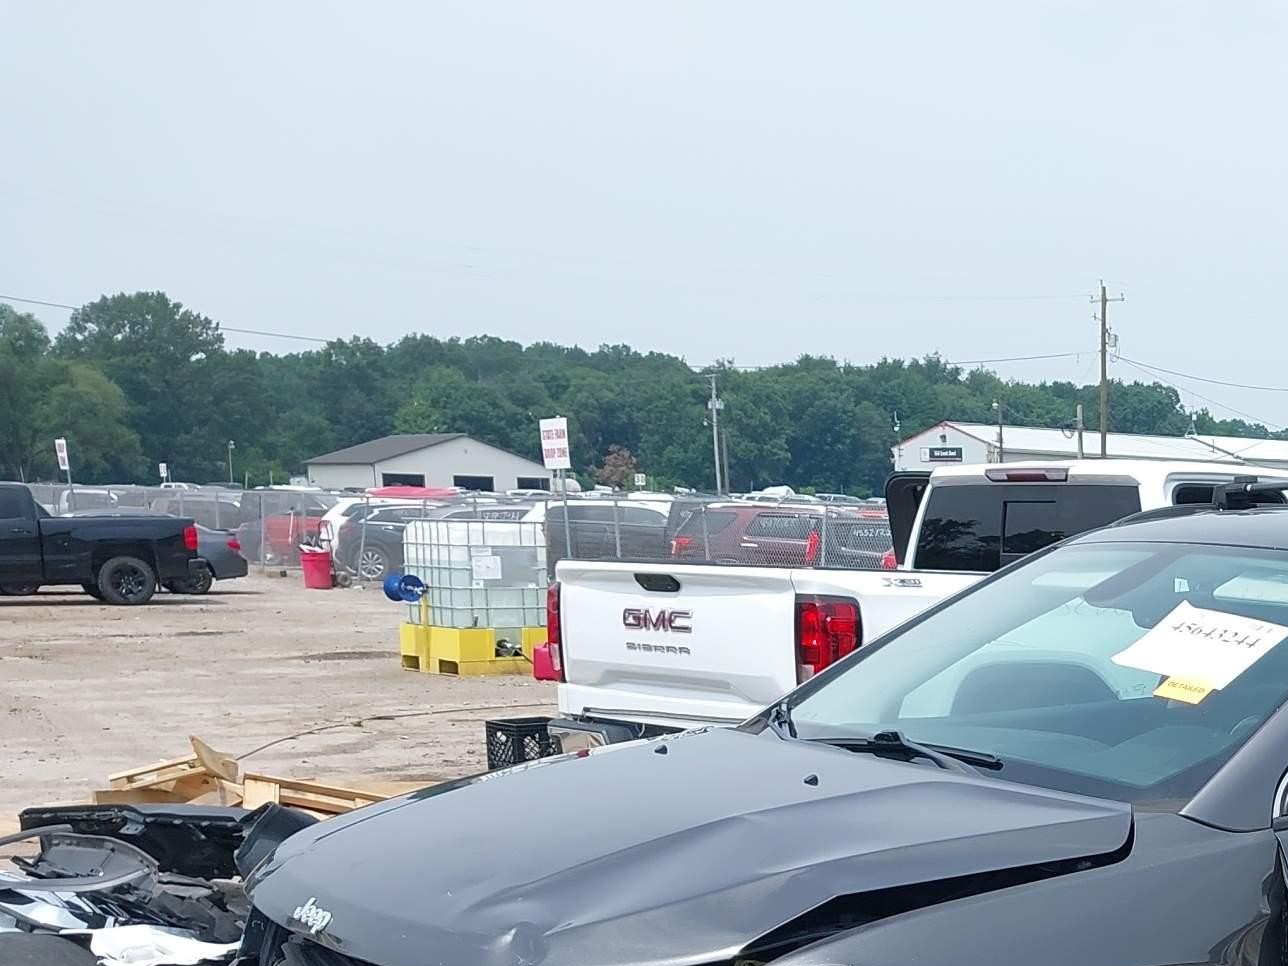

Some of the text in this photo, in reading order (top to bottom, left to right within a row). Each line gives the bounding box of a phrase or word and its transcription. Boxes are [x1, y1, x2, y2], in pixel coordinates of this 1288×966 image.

[623, 608, 693, 633] GMC
[625, 641, 692, 656] SIERRA
[1167, 680, 1206, 694] DETAILED
[292, 896, 332, 934] Jeep
